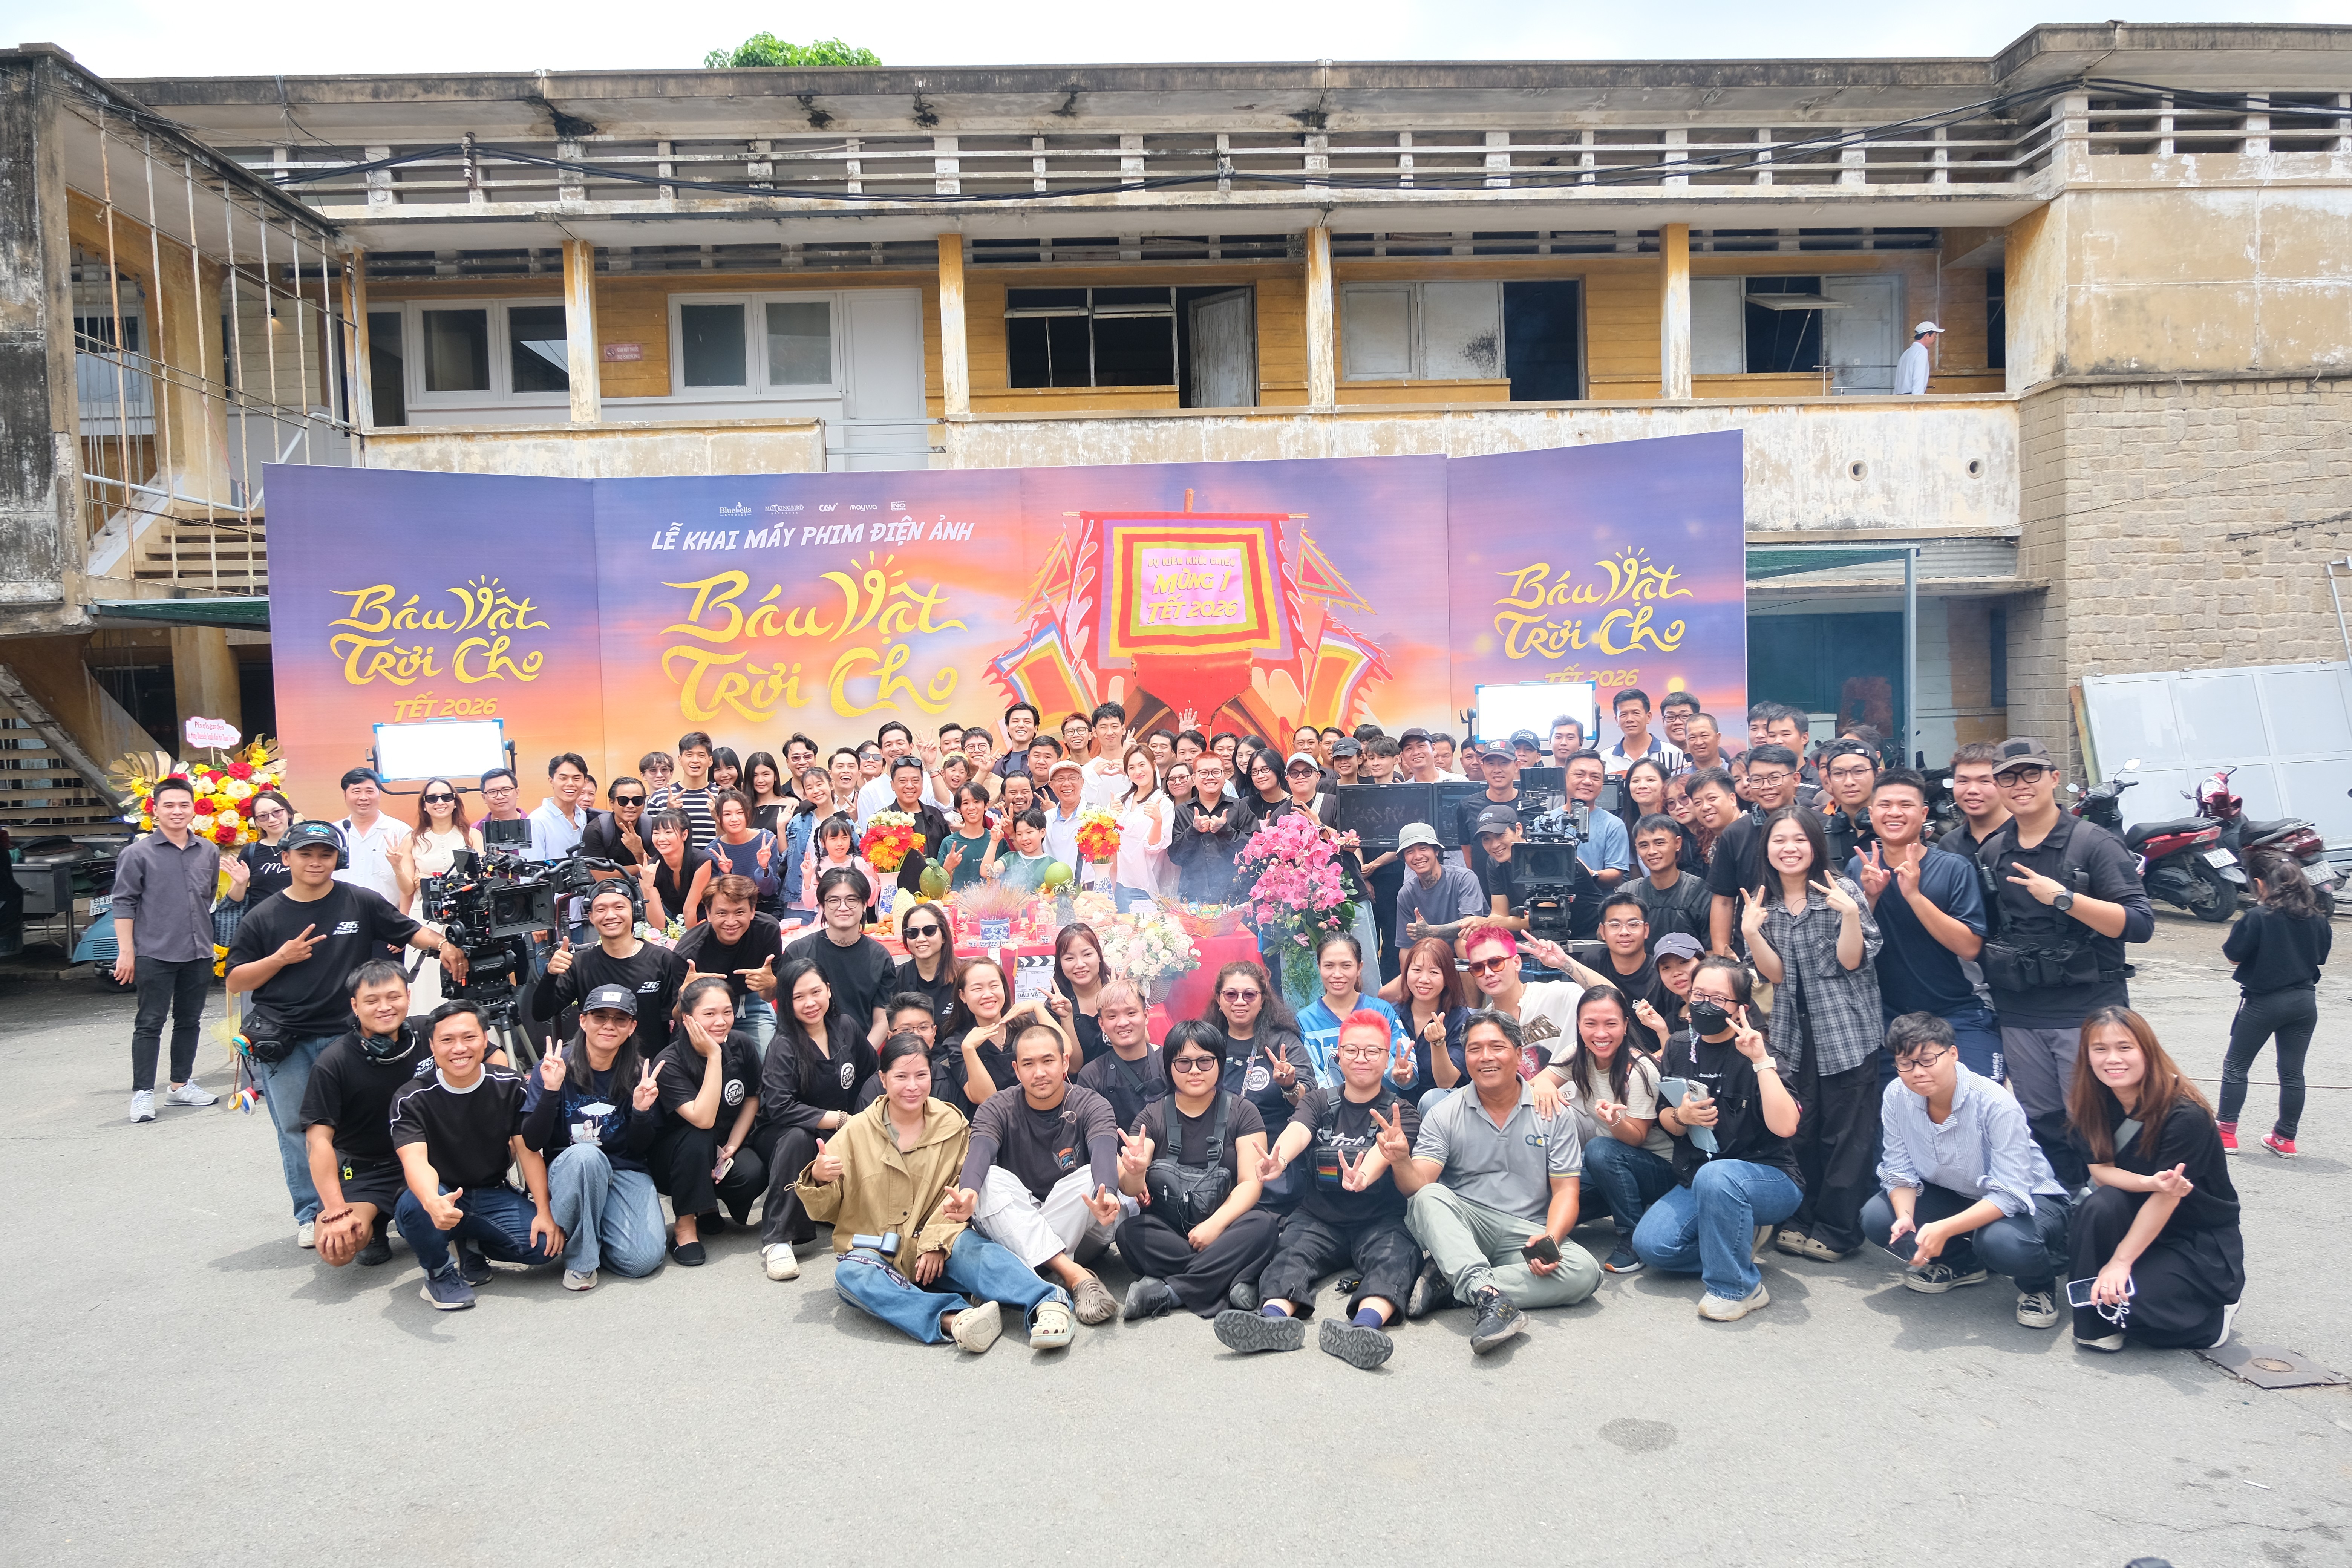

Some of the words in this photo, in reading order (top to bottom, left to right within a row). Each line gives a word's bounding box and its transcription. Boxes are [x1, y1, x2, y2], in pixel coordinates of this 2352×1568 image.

[819, 504, 836, 512] CGV
[652, 522, 683, 550] LỄ
[683, 530, 740, 551] KHAI
[744, 522, 797, 549] MÁY
[801, 523, 865, 546] PHIM
[870, 516, 922, 547] ĐIỆN
[928, 515, 974, 541] ẢNH
[1152, 568, 1214, 595] MÙNG
[1219, 570, 1231, 591] 1
[1493, 563, 1602, 608] Báu
[1594, 557, 1694, 606] Vật
[328, 584, 456, 633] Báu
[447, 586, 550, 636] Vật
[659, 570, 834, 643] Báu
[819, 568, 968, 644] Vật
[1147, 593, 1187, 624] TẾT
[1186, 600, 1239, 618] 2026
[1599, 606, 1686, 655] Cho
[453, 635, 544, 684] Cho
[827, 643, 958, 718] Cho
[194, 721, 225, 730] Pixelsgarden
[393, 691, 438, 723] TẾT
[442, 698, 498, 717] 2026
